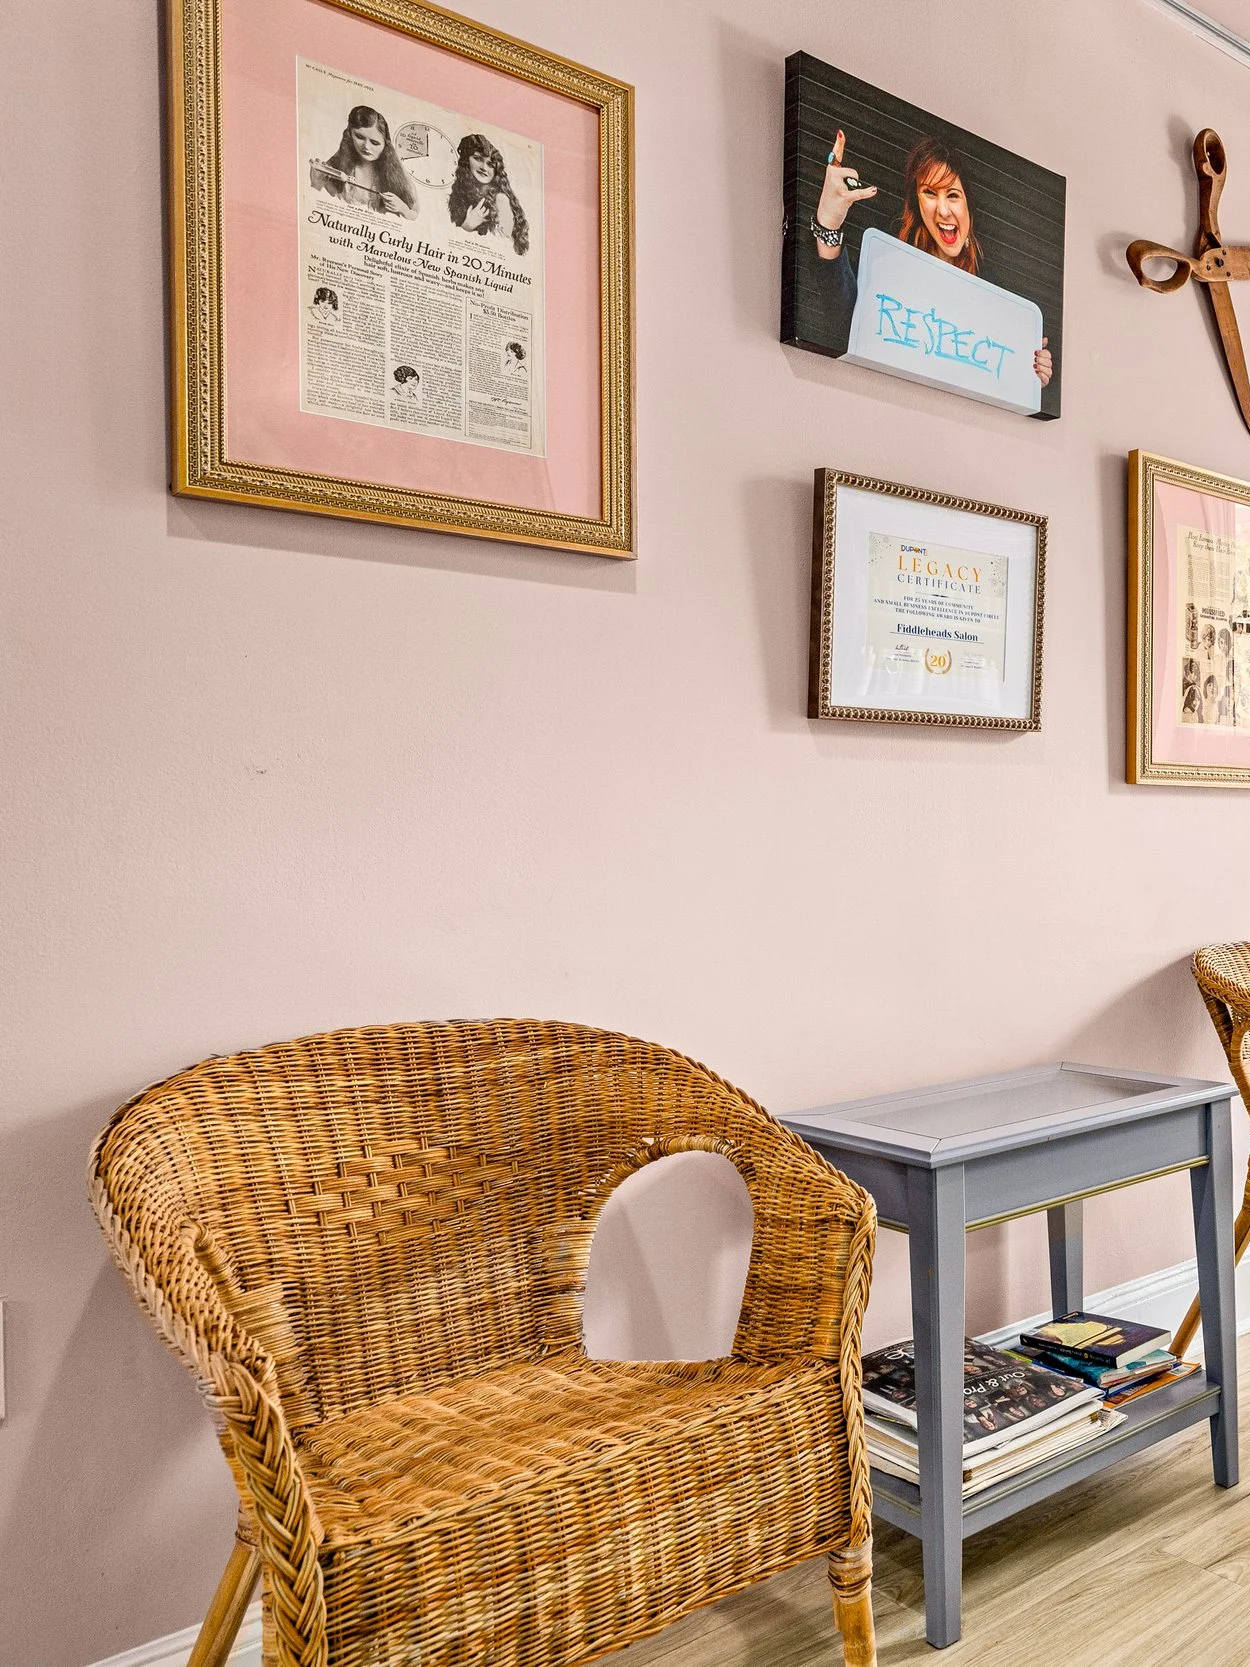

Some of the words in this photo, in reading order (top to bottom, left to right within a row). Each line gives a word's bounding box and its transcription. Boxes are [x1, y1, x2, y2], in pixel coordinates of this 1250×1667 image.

[308, 210, 376, 242] Naturally
[379, 230, 413, 253] Curly
[416, 241, 446, 260] Hair
[447, 251, 460, 265] in
[462, 255, 482, 270] 20
[482, 260, 532, 286] Minutes
[329, 236, 354, 249] with
[356, 241, 412, 265] Marvelous
[412, 257, 441, 272] New
[443, 265, 482, 284] Spanish
[484, 277, 514, 294] Liquid
[875, 293, 1015, 380] RESPECT
[898, 555, 982, 583] LEGACY
[897, 573, 981, 594] CERTIFICATE
[896, 623, 952, 639] Fiddleheads
[953, 630, 979, 642] Salon
[930, 655, 946, 668] 20
[984, 1378, 999, 1388] &
[999, 1371, 1025, 1382] Out
[963, 1383, 987, 1395] Pro
